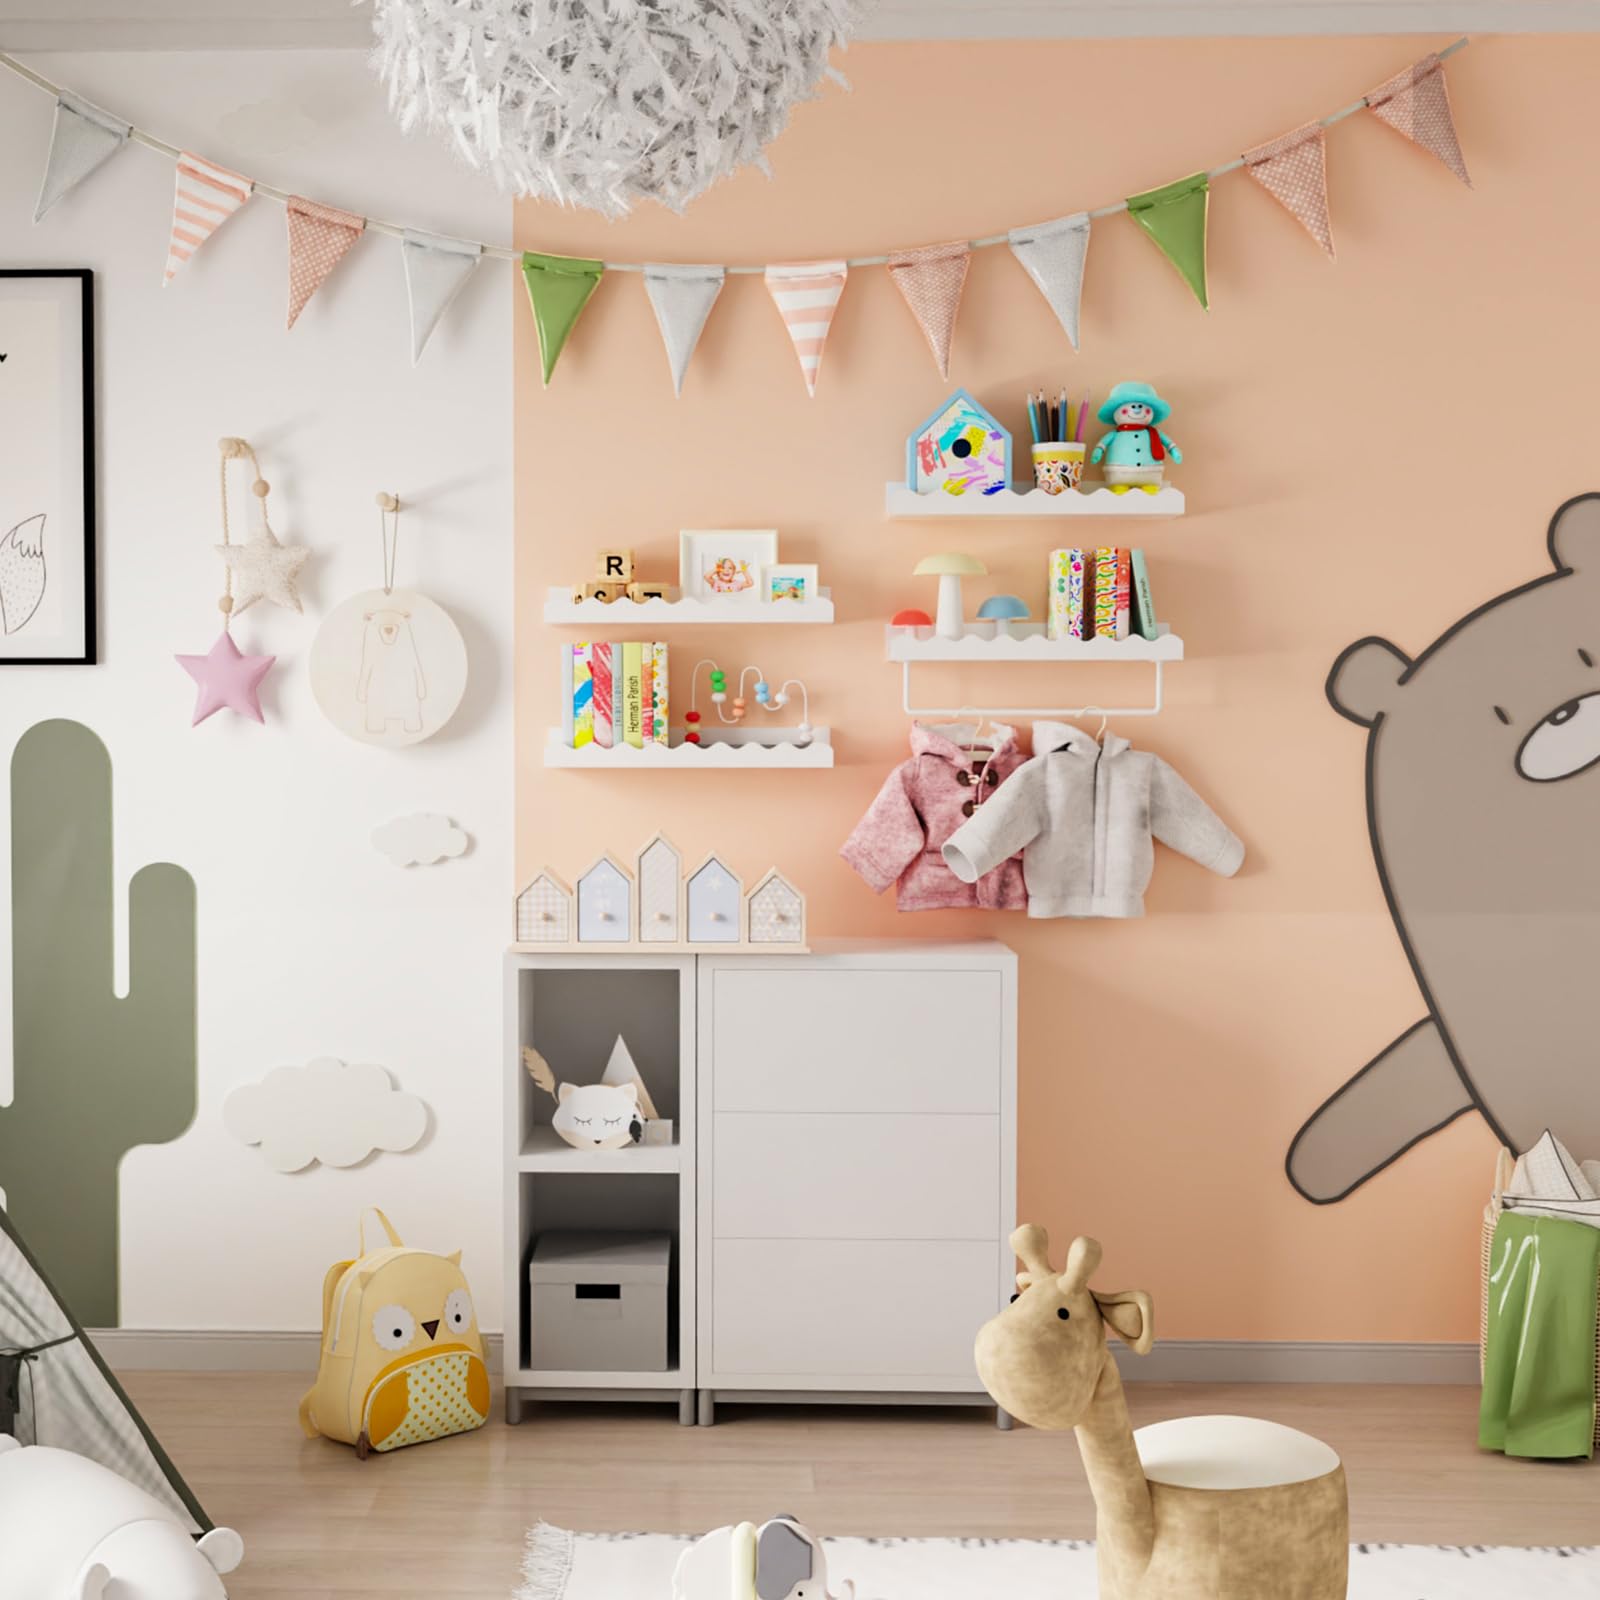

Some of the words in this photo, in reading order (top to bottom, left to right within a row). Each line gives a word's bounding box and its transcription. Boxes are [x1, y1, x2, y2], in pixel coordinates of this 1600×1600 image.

[606, 555, 624, 576] R
[627, 675, 639, 699] Parish
[627, 701, 639, 733] Herman
